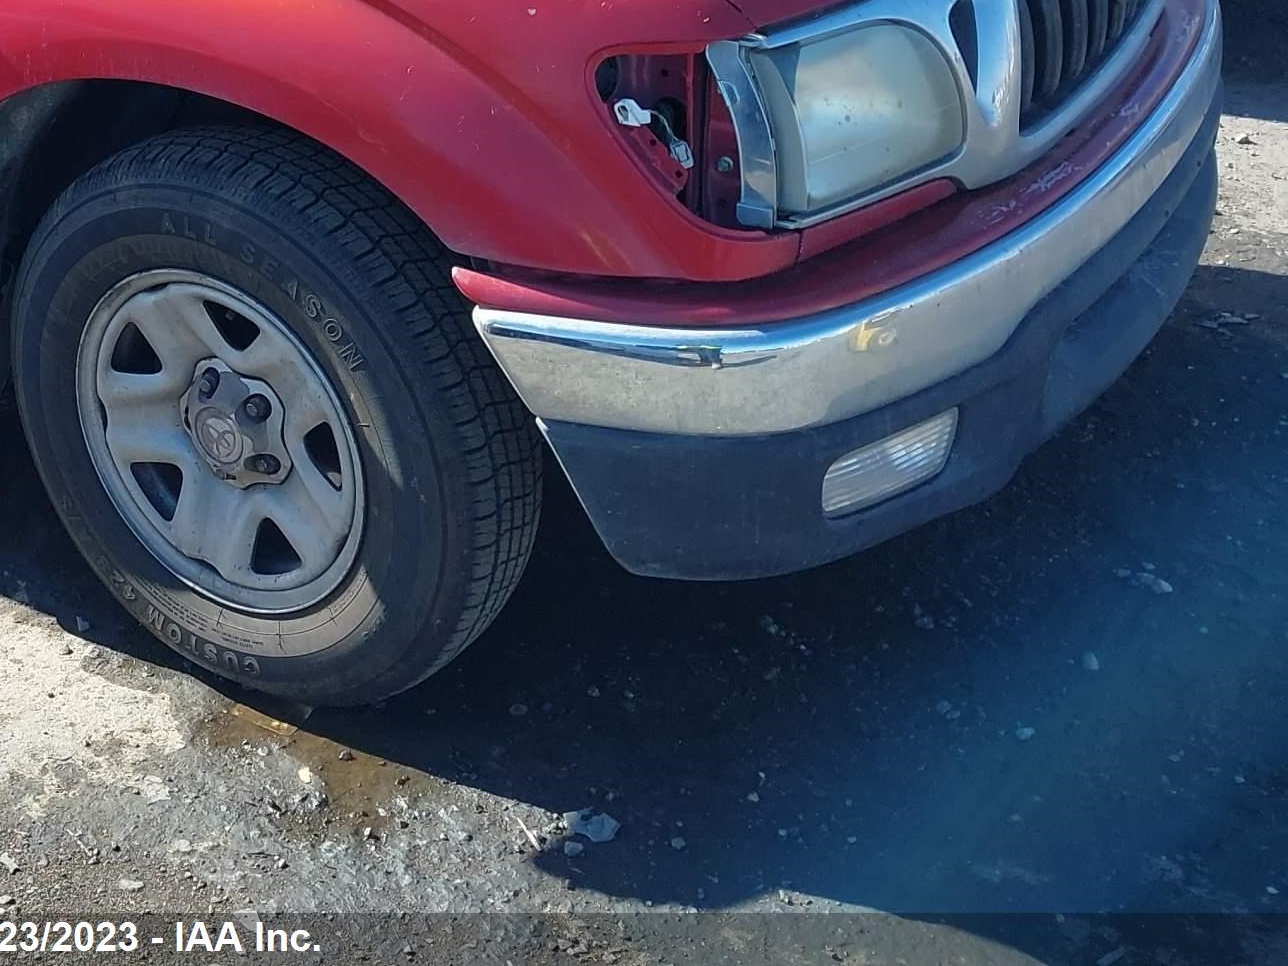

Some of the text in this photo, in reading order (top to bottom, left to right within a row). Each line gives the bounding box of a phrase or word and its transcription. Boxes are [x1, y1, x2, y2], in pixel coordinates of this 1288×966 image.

[160, 212, 365, 372] ALL SEASON
[144, 603, 261, 676] CUSTOM
